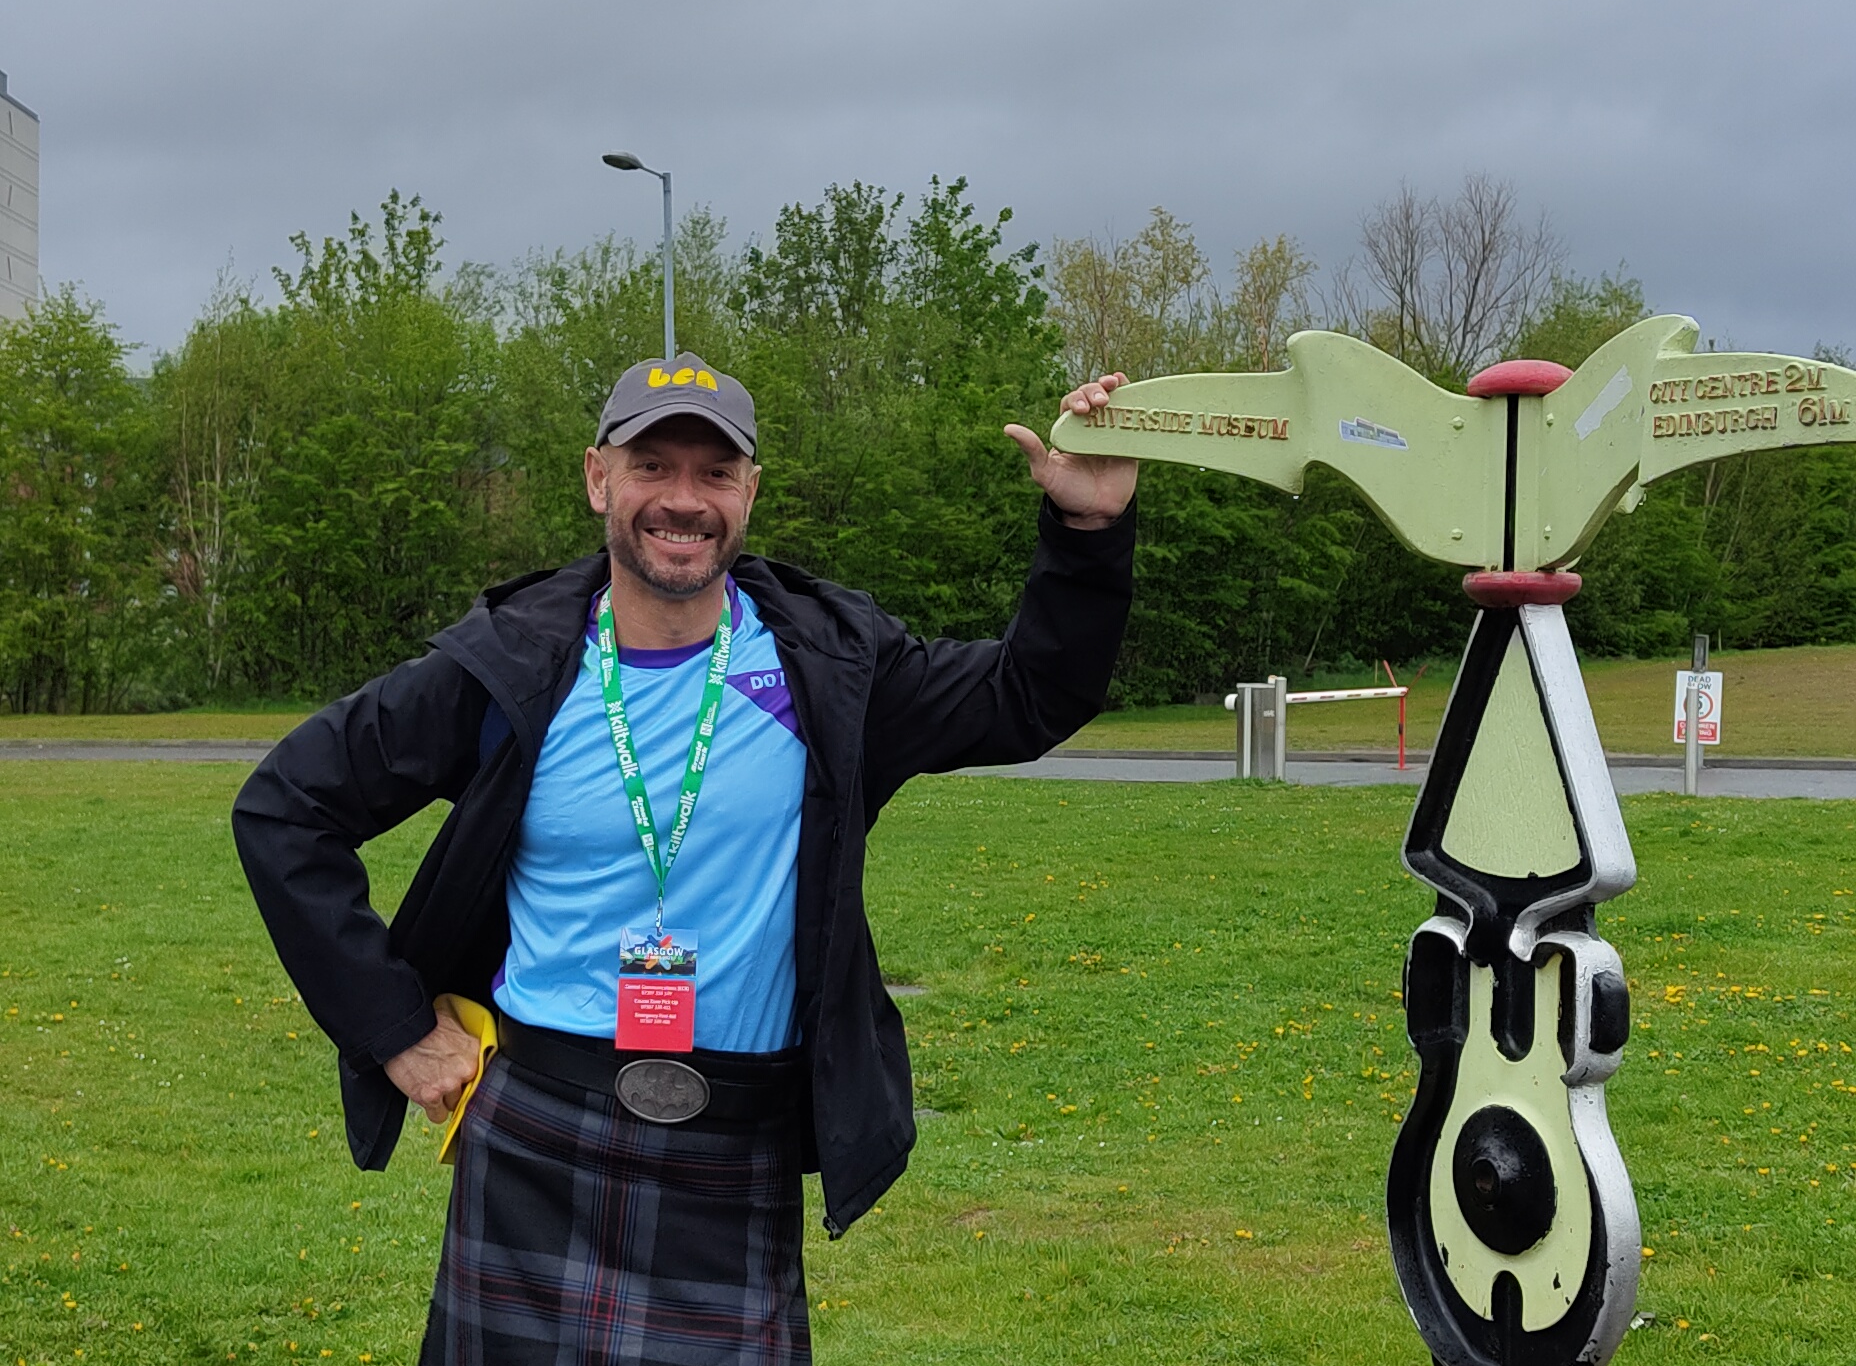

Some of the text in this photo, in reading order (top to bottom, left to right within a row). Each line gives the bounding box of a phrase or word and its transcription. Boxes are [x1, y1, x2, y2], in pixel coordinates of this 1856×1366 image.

[1650, 376, 1693, 404] CITY
[1695, 369, 1782, 400] CENTRE
[1083, 404, 1290, 441] RIVERSIDE MUSEUM
[1653, 404, 1779, 438] EDINBURGH
[710, 622, 732, 674] kiltwalk
[749, 673, 777, 691] DO
[1688, 675, 1712, 683] DEAD
[609, 714, 639, 780] kiltwalk
[669, 790, 697, 854] kiltwalk
[634, 946, 684, 956] GLASGOW
